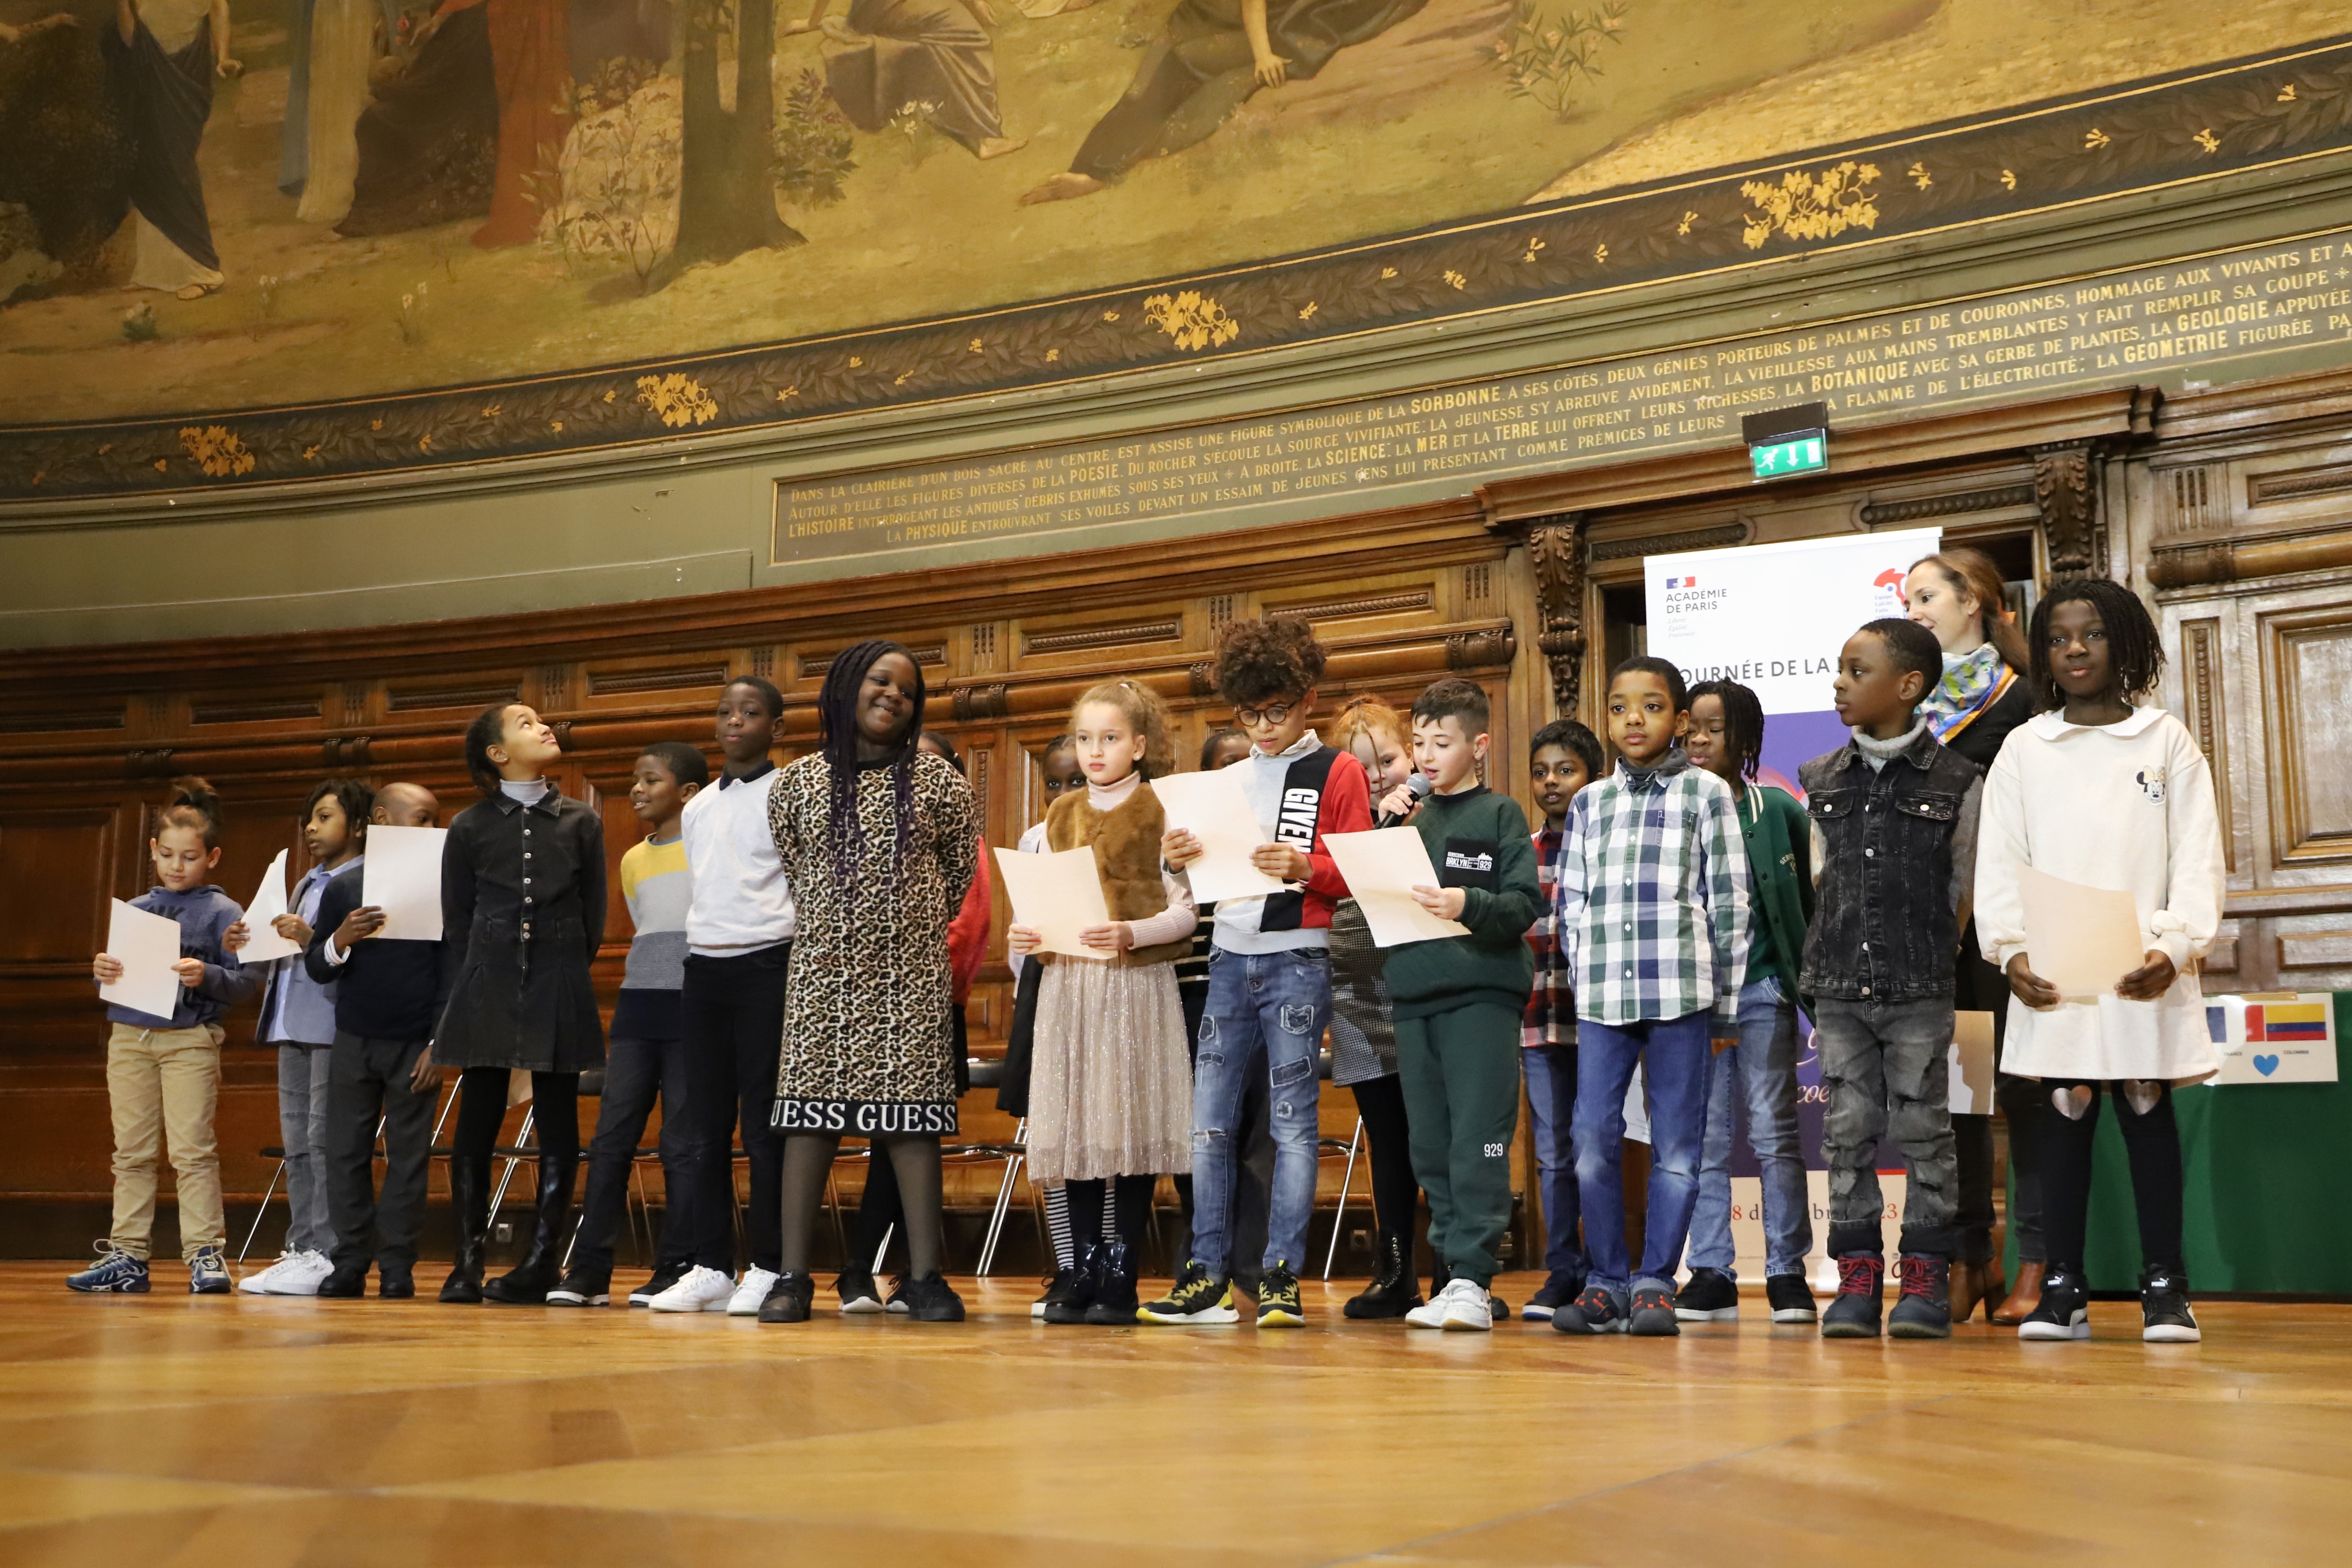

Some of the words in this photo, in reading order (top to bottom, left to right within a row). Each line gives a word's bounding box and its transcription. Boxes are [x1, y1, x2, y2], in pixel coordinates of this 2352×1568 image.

[792, 488, 823, 502] DANS
[831, 486, 845, 498] LA
[921, 472, 947, 485] D'UN
[954, 469, 980, 481] BOIS
[989, 459, 1030, 476] SACRÉ,
[1036, 458, 1052, 470] AU
[1118, 445, 1141, 458] EST
[1148, 437, 1192, 454] ASSISE
[1199, 433, 1223, 446] UNE
[1231, 425, 1274, 441] FIGURE
[1280, 411, 1362, 434] SYMBOLIQUE
[1368, 408, 1383, 421] DE
[1389, 405, 1406, 418] LA
[1411, 387, 1505, 413] SORBONNE.
[1508, 386, 1518, 399] A
[1523, 382, 1548, 397] SES
[1553, 373, 1603, 391] CÔTÉS,
[1608, 366, 1646, 383] DEUX
[1654, 356, 1708, 375] GÉNIES
[1718, 342, 1791, 365] PORTEURS
[1798, 337, 1817, 352] DE
[1826, 324, 1891, 347] PALMES
[1902, 319, 1922, 334] ET
[1930, 314, 1950, 330] DE
[1960, 294, 2070, 324] COURONNES,
[2076, 277, 2165, 304] HOMMAGE
[2174, 268, 2211, 287] AUX
[2222, 252, 2300, 277] VIVANTS
[2310, 246, 2332, 262] ET
[789, 505, 837, 520] AUTOUR
[844, 498, 880, 512] D'ELLE
[887, 495, 906, 507] LES
[913, 488, 963, 504] FIGURES
[970, 479, 1025, 497] DIVERSES
[1033, 477, 1046, 488] DE
[1051, 475, 1065, 486] LA
[1070, 464, 1123, 483] POESIE.
[1128, 462, 1144, 475] DU
[1148, 456, 1196, 473] ROCHER
[1204, 446, 1260, 465] S'ÉCOULE
[1267, 444, 1282, 456] LA
[1288, 434, 1338, 452] SOURCE
[1430, 418, 1446, 431] LA
[1455, 406, 1524, 427] JEUNESSE
[1555, 391, 1618, 412] ABREUVE
[1724, 371, 1743, 385] LA
[1748, 356, 1835, 380] VIEILLESSE
[1845, 349, 1877, 365] AUX
[1884, 338, 1937, 358] MAINS
[1946, 316, 2068, 348] TREMBLANTES
[2077, 312, 2089, 326] Y
[2097, 305, 2133, 323] FAIT
[2145, 290, 2221, 315] REMPLIR
[2233, 284, 2257, 299] SA
[2266, 270, 2329, 293] COUPE
[789, 517, 854, 537] L'HISTOIRE
[858, 509, 938, 528] INTERROGEANT
[943, 506, 961, 518] LES
[966, 498, 1018, 515] ANTIQUES
[1025, 493, 1064, 508] DÉBRIS
[1070, 483, 1120, 502] EXHUMÉS
[1129, 480, 1158, 494] SOUS
[1163, 476, 1183, 489] SES
[1189, 471, 1218, 485] YEUX
[1240, 465, 1249, 478] A
[1255, 459, 1301, 476] DROITE,
[1308, 457, 1321, 469] LA
[1396, 443, 1411, 456] LA
[1417, 435, 1447, 452] MER
[1453, 434, 1467, 447] ET
[1475, 432, 1490, 444] LA
[1494, 421, 1538, 441] TERRE
[1546, 419, 1566, 434] LUI
[1573, 409, 1631, 429] OFFRENT
[1641, 401, 1685, 418] LEURS
[1696, 387, 1780, 410] RICHESSES,
[1786, 382, 1804, 396] LA
[1812, 361, 1908, 392] BOTANIQUE
[1912, 358, 1950, 376] AVEC
[1958, 354, 1979, 368] SA
[1985, 344, 2035, 363] GERBE
[2043, 339, 2062, 355] DE
[2151, 322, 2171, 336] LA
[2178, 301, 2269, 331] GEOLOGIE
[2276, 288, 2351, 315] APPUYÉE
[887, 530, 901, 542] LA
[906, 521, 967, 540] PHYSIQUE
[972, 513, 1051, 532] ENTROUVRANT
[1060, 509, 1081, 521] SES
[1088, 502, 1129, 517] VOILES
[1139, 495, 1184, 511] DEVANT
[1191, 491, 1208, 504] UN
[1216, 484, 1262, 501] ESSAIM
[1272, 480, 1288, 493] DE
[1295, 472, 1346, 489] JEUNES
[1395, 462, 1415, 475] LUI
[1424, 448, 1506, 470] PRÉSENTANT
[1517, 439, 1568, 457] COMME
[1578, 427, 1645, 448] PRÉMICES
[1654, 423, 1671, 437] DE
[1679, 415, 1725, 433] LEURS
[1846, 385, 1915, 407] FLAMME
[1928, 380, 1947, 395] DE
[2097, 353, 2119, 368] LA
[2124, 330, 2228, 363] GEOMETRIE
[2239, 320, 2313, 345] FIGURÉE
[1666, 589, 1727, 602] ACADÉMIE
[1667, 605, 1680, 613] DE
[1685, 601, 1717, 612] PARIS
[1680, 659, 1763, 685] OURNÉE
[1771, 660, 1796, 677] DE
[1805, 657, 1830, 675] LA
[1277, 788, 1319, 853] GIVEN
[1446, 857, 1468, 867] BRKLYN
[1480, 860, 1492, 870] 929
[770, 1099, 846, 1130] UESS
[857, 1103, 955, 1132] GUESS
[1484, 1143, 1503, 1157] 929
